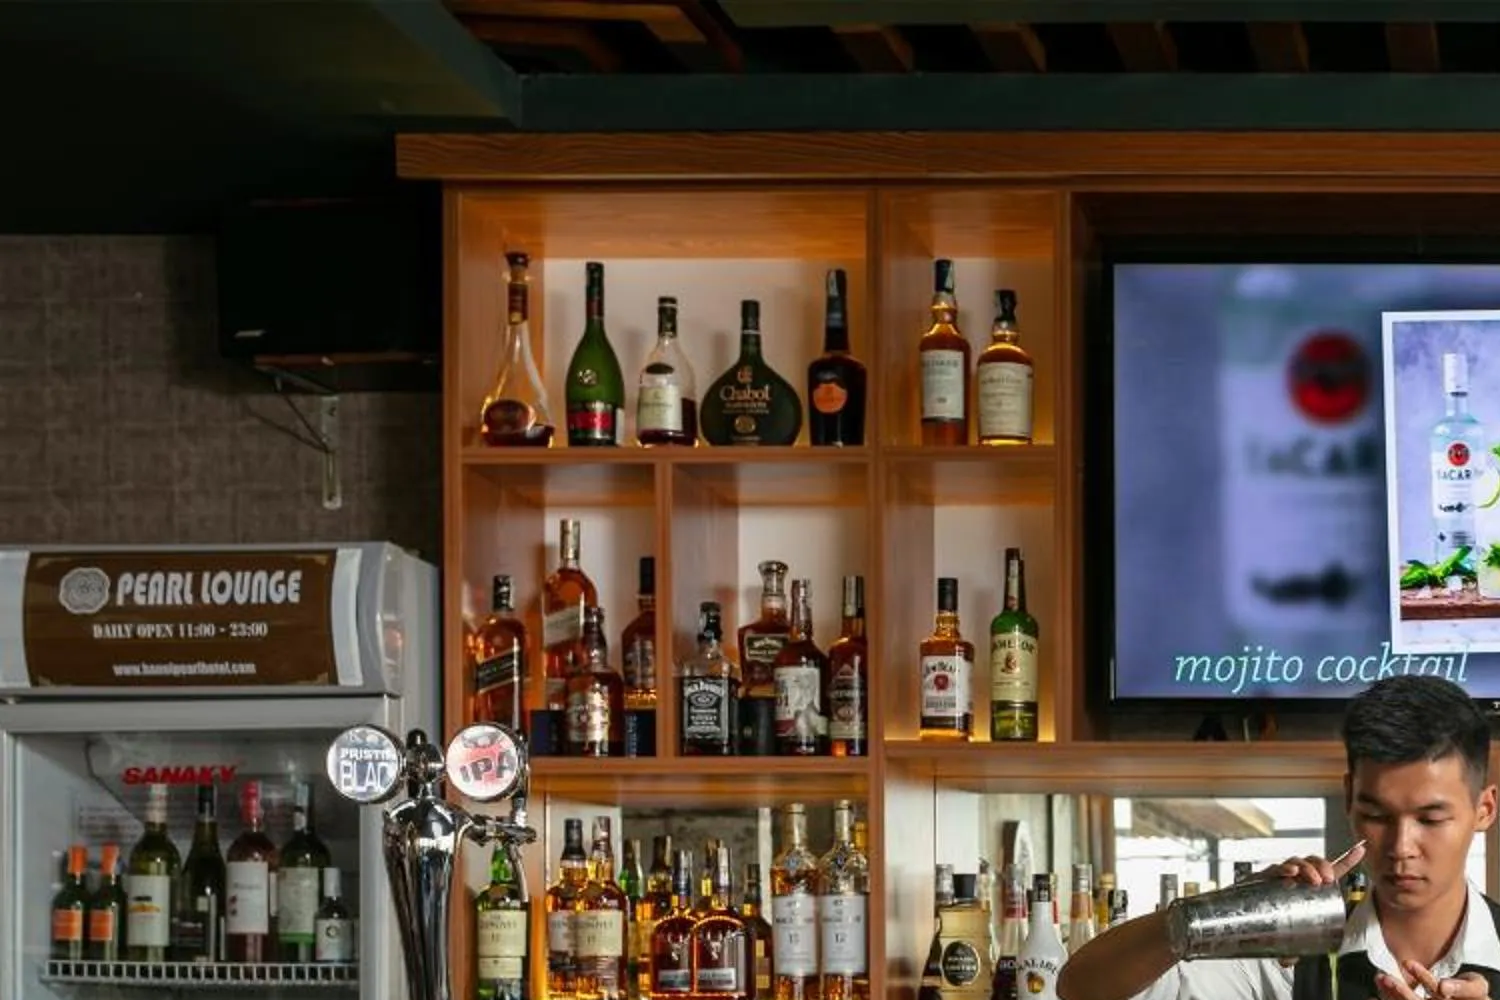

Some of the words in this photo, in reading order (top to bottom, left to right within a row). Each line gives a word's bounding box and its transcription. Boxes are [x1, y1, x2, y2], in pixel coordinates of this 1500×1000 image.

[116, 572, 195, 606] PEARL
[200, 570, 302, 605] LOUNGE
[93, 624, 133, 639] DAILY
[137, 623, 174, 639] OPEN
[178, 623, 215, 638] 11:00
[229, 622, 268, 637] 23:00
[1175, 645, 1304, 695] mojito
[1316, 641, 1473, 683] cocktail
[121, 765, 237, 784] SANAKY
[459, 749, 517, 783] IPA
